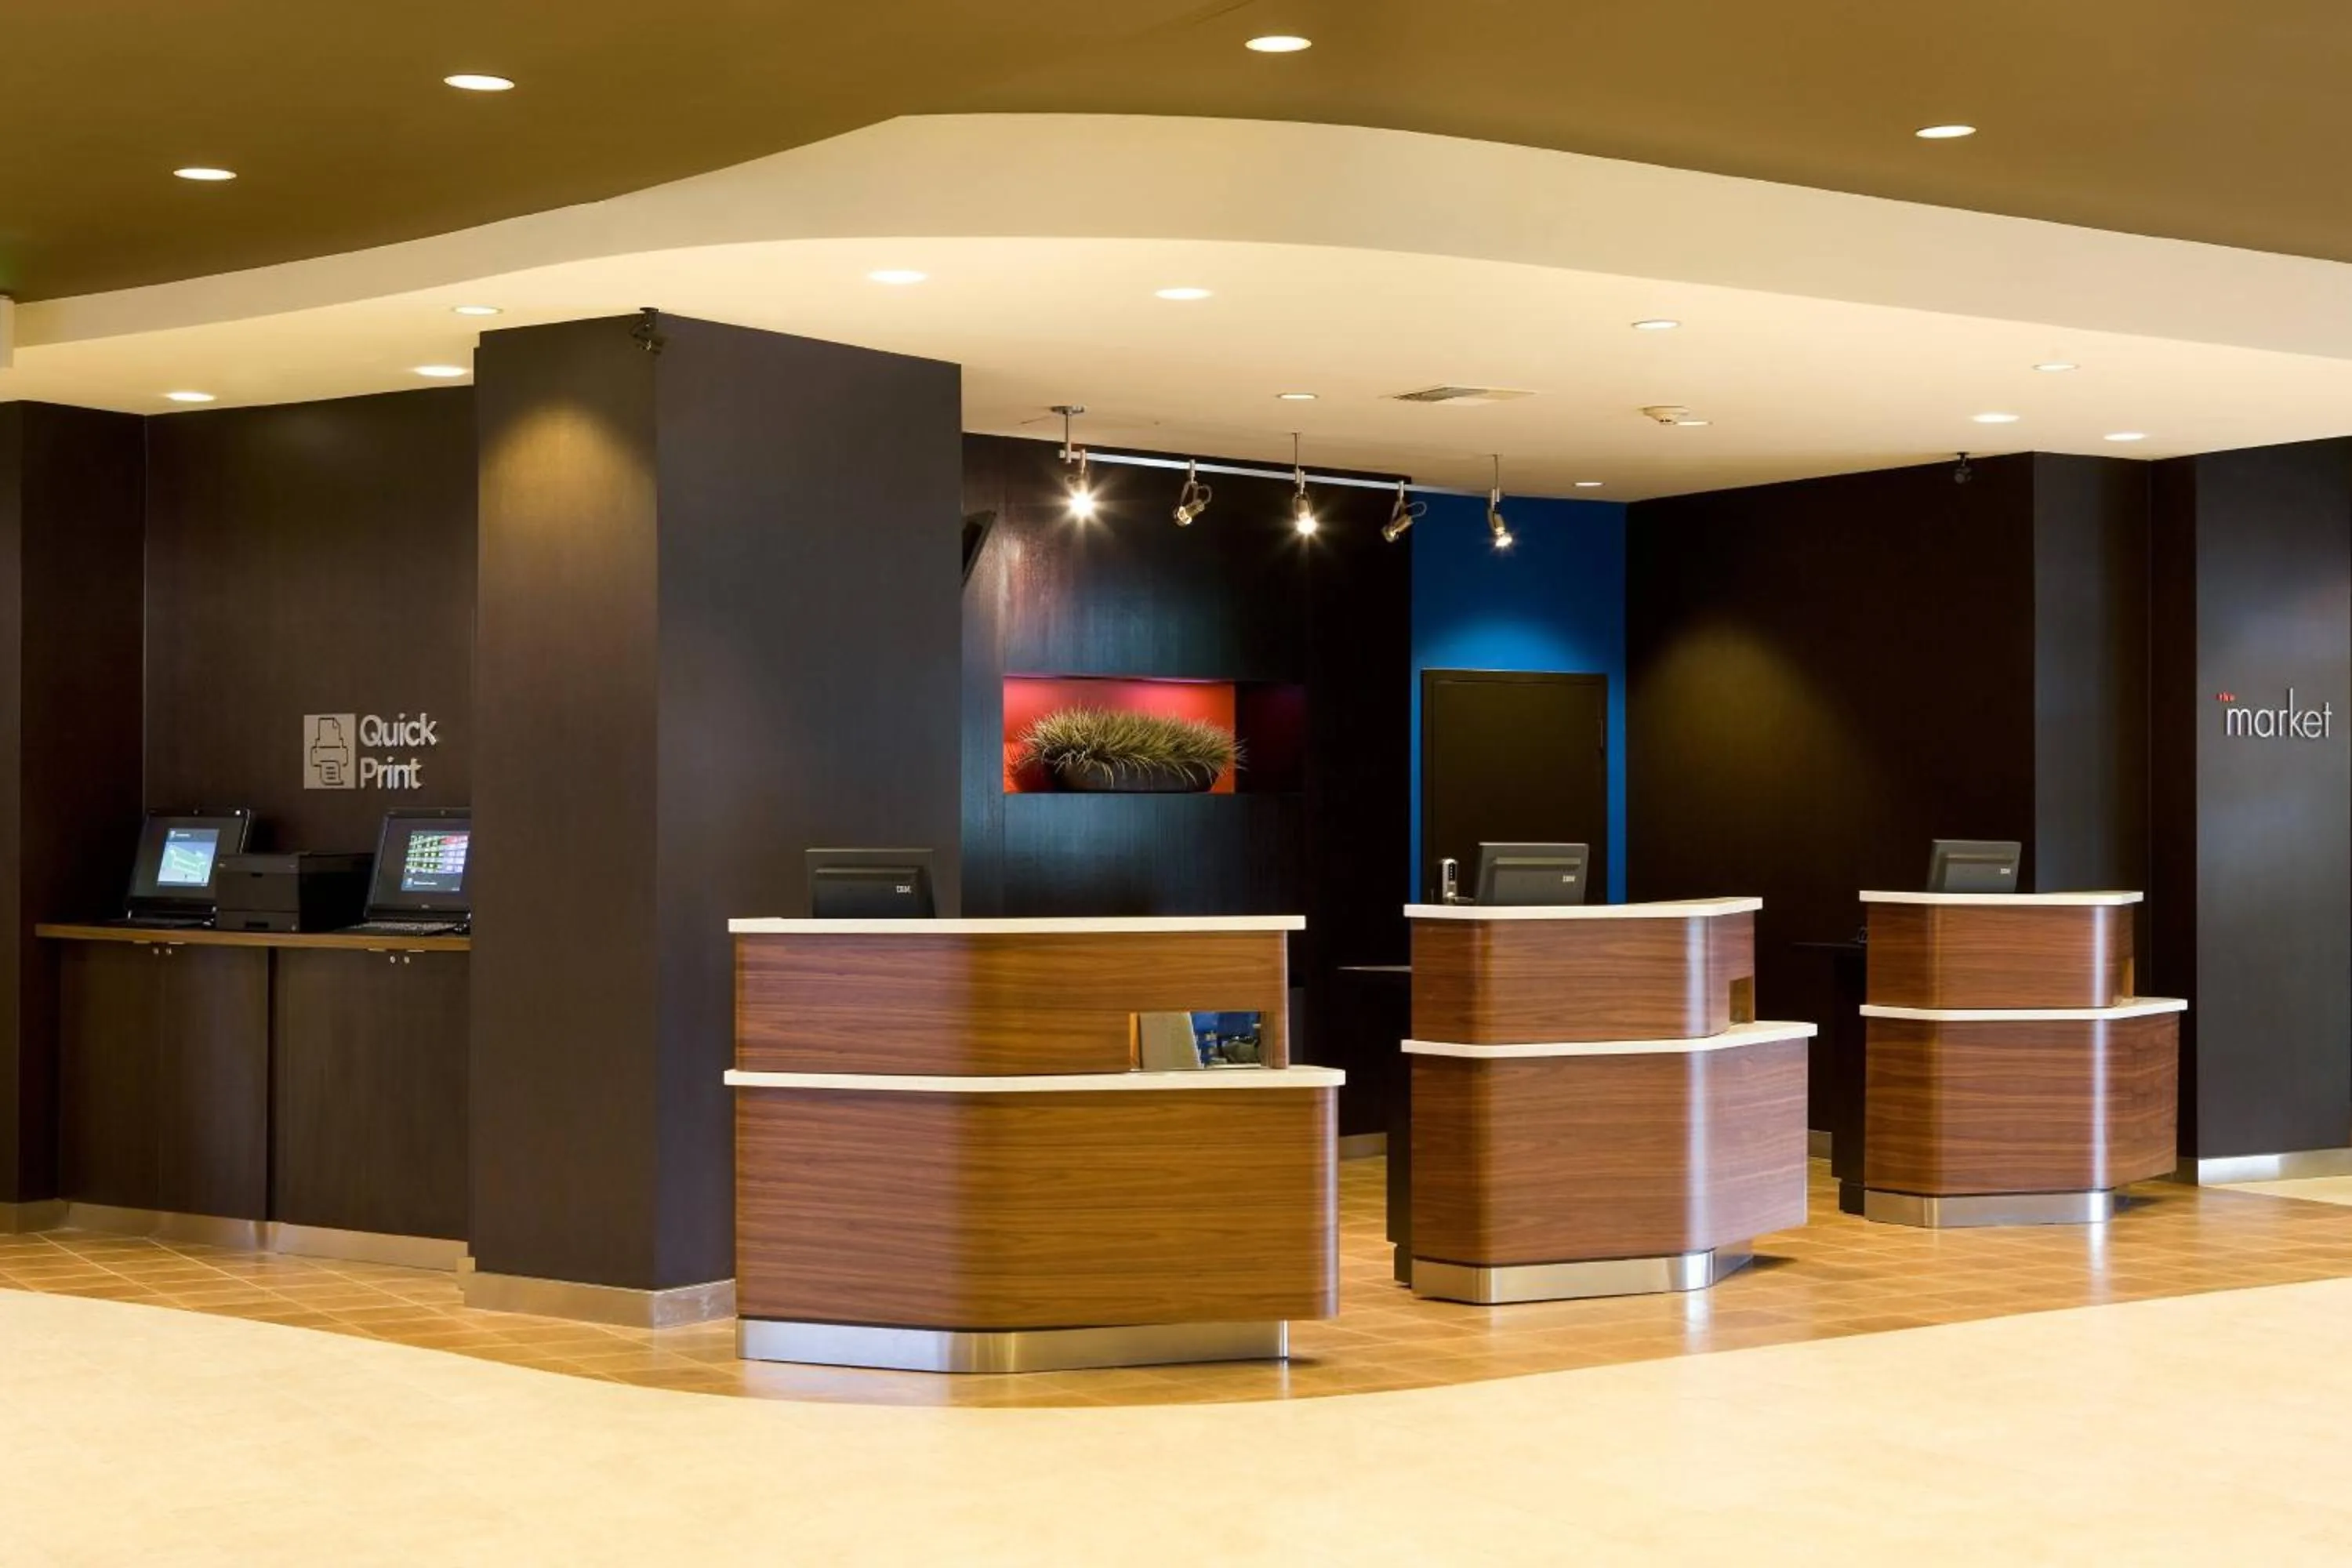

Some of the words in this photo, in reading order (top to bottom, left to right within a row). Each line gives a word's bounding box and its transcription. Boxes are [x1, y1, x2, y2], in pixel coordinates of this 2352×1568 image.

[359, 713, 437, 747] Quick
[2226, 688, 2332, 739] market
[360, 756, 423, 789] Print
